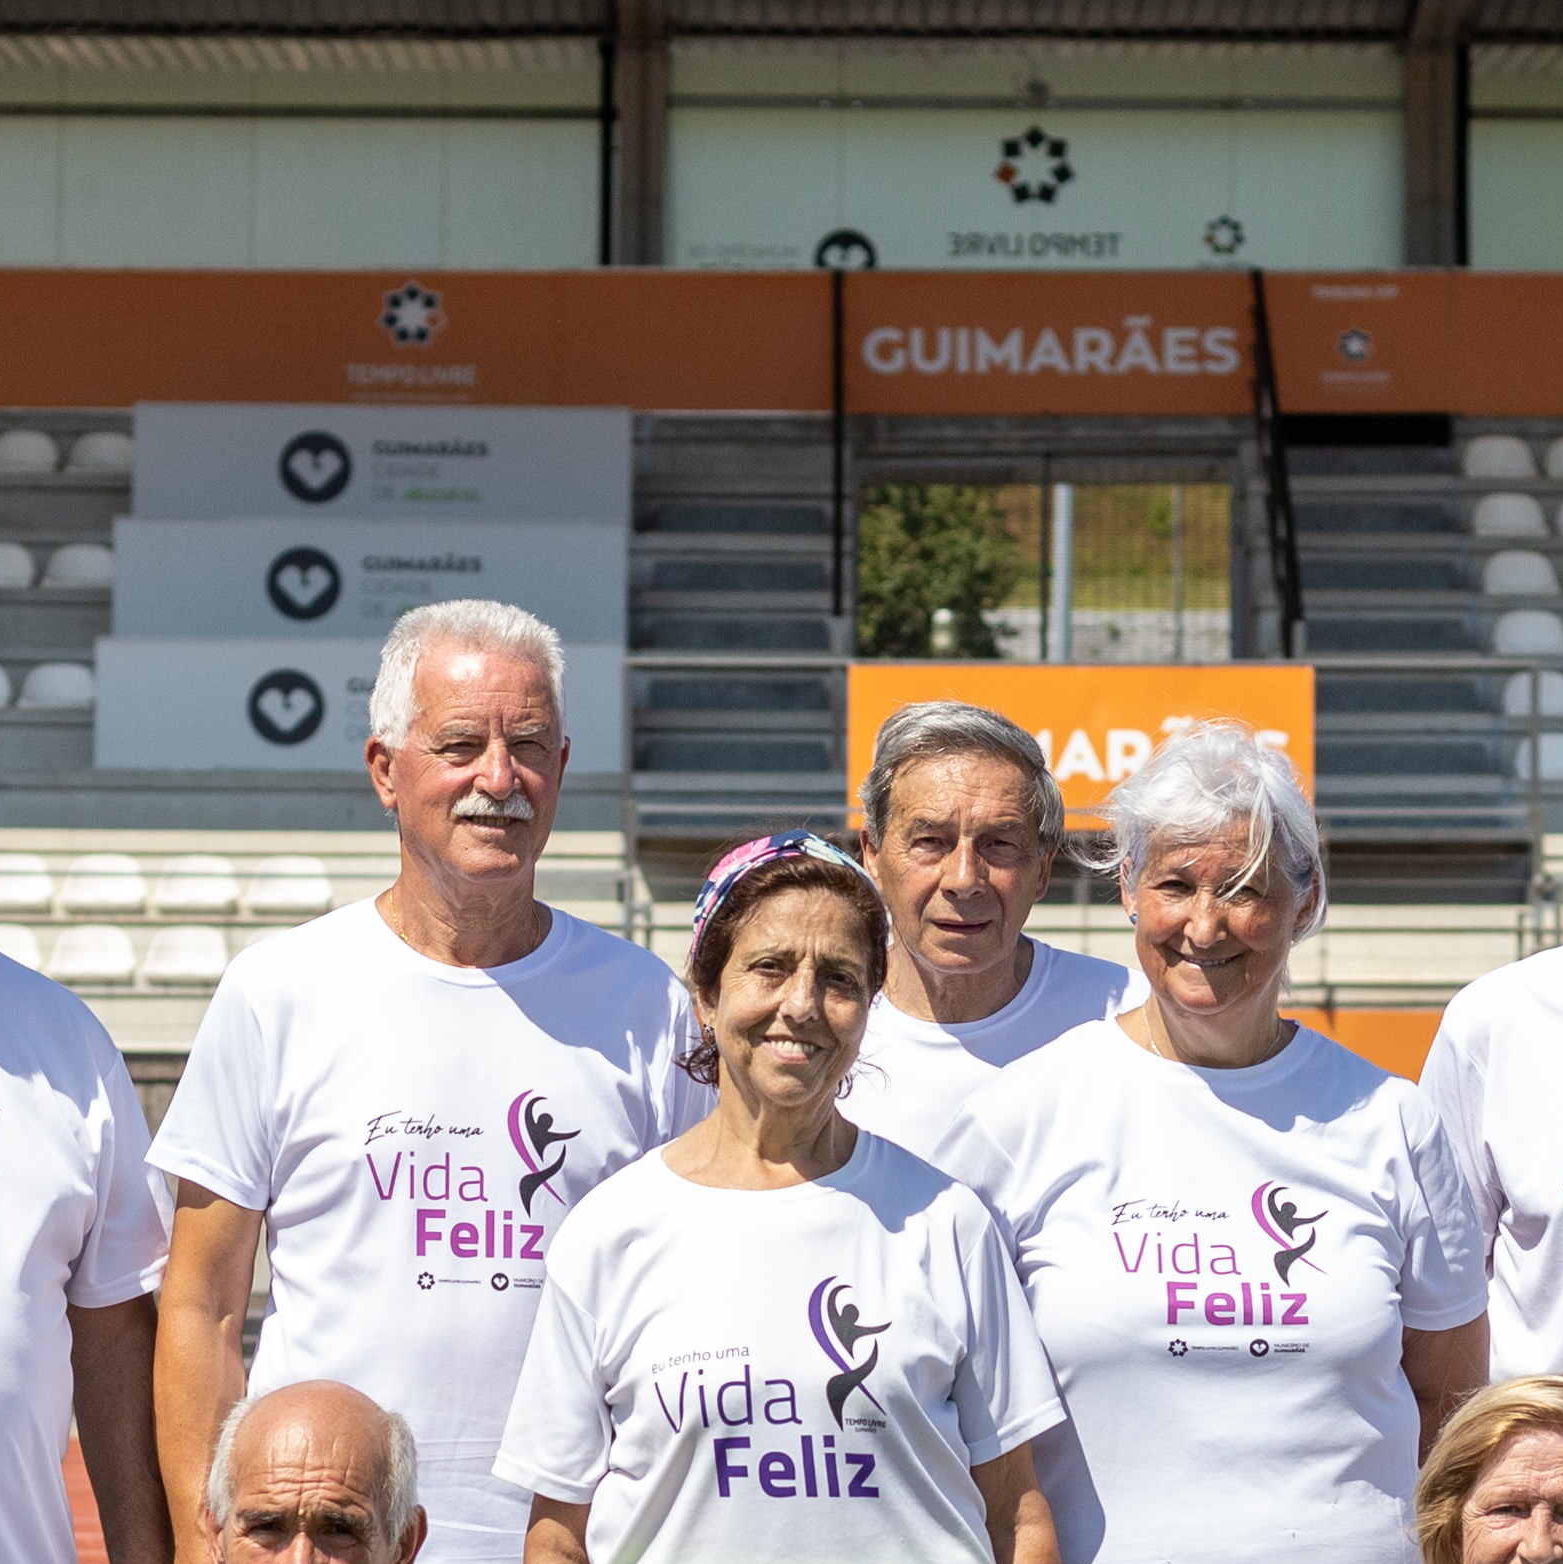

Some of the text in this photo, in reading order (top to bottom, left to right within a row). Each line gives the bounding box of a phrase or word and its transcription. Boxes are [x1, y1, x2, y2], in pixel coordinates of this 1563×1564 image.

[861, 314, 1241, 376] GUIMARÃES
[364, 1110, 484, 1145] Eu tenho uma
[365, 1151, 488, 1202] Vida
[416, 1208, 545, 1260] Feliz
[1111, 1199, 1230, 1226] Eu tenho uma
[1113, 1231, 1242, 1275] Vida
[1166, 1281, 1309, 1326] Feliz
[651, 1346, 750, 1374] eu tenho uma
[654, 1364, 802, 1434] Vida
[845, 1418, 867, 1426] TEMPO
[713, 1435, 880, 1498] Feliz
